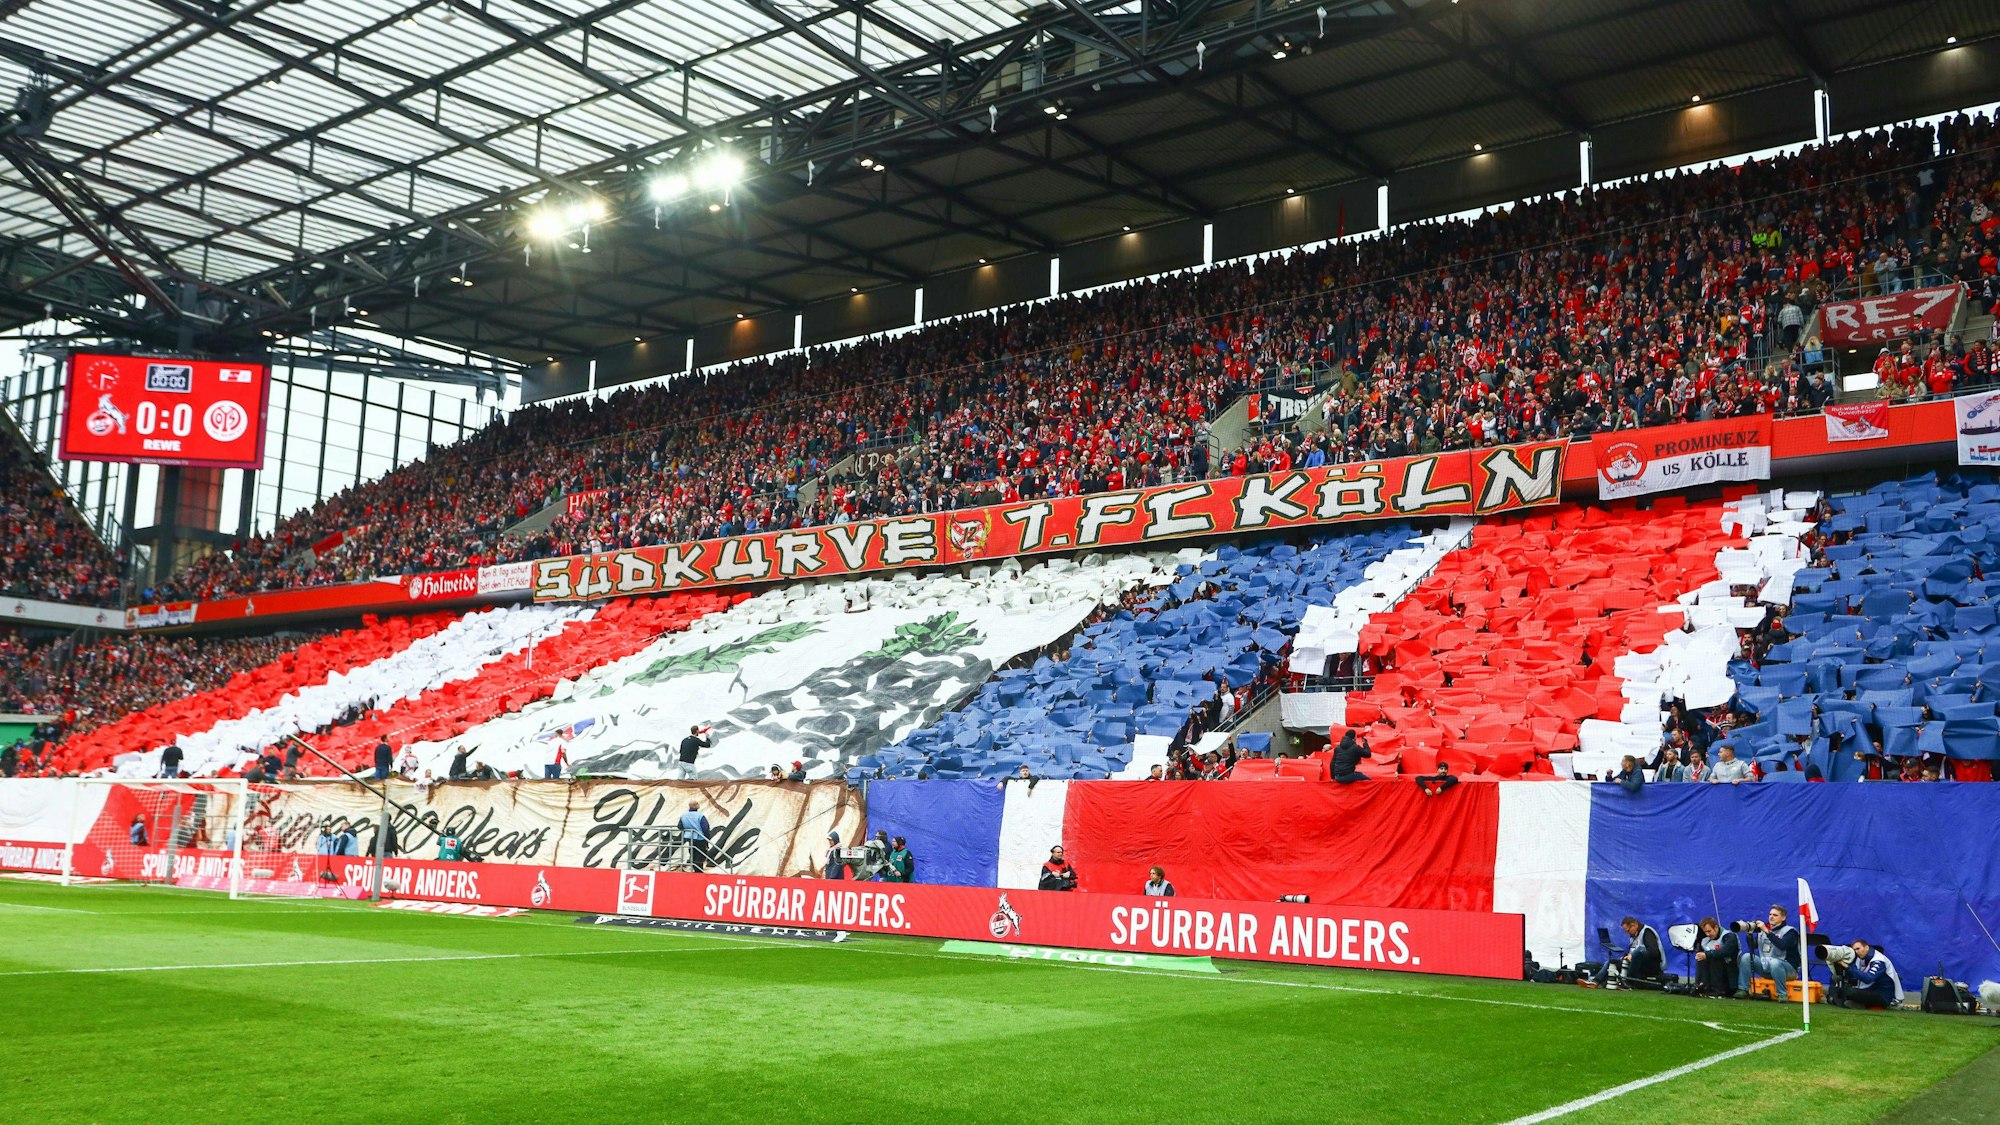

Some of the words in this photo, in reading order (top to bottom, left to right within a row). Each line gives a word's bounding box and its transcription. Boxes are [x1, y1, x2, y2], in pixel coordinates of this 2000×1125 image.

[1847, 325, 1909, 341] CRE
[151, 375, 186, 388] 00:00
[143, 439, 182, 451] REWE
[1654, 430, 1760, 457] PROMINENZ
[1690, 450, 1749, 472] KÖLLE
[1235, 444, 1565, 529] KÖLN
[534, 518, 938, 599] SÜDKURVE
[422, 573, 476, 599] Holweide
[141, 849, 195, 879] SPÜBAR
[343, 860, 412, 895] SPÜBAR
[413, 868, 481, 900] ANDERS.
[703, 878, 806, 922] SPÜRBAR
[811, 889, 911, 930] ANDERS.
[1109, 900, 1258, 954] SPÜRBAR
[1269, 914, 1421, 966] ANDERS.
